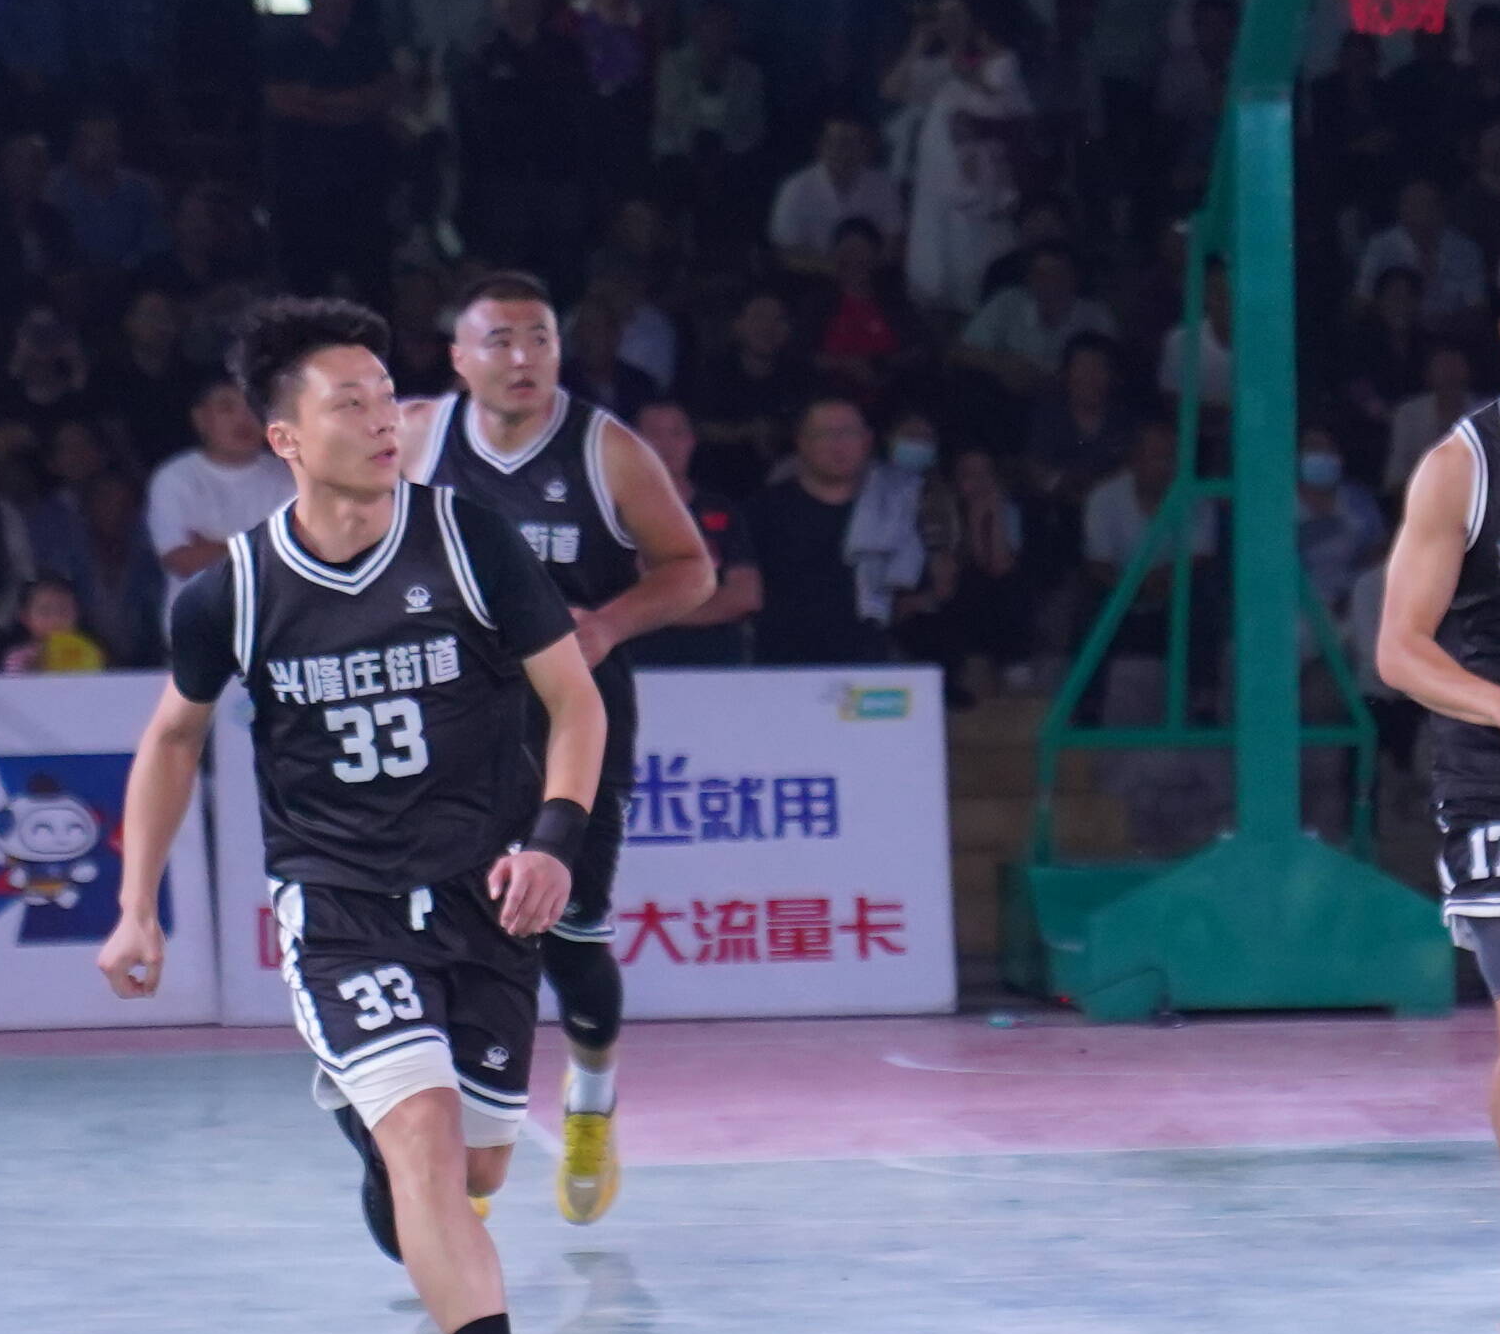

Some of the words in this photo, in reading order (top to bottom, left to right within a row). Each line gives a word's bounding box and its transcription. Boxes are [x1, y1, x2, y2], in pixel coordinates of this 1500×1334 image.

[265, 637, 462, 706] 兴隆庄街道
[323, 698, 431, 784] 33
[619, 896, 908, 966] 大流量卡
[337, 965, 425, 1032] 33
